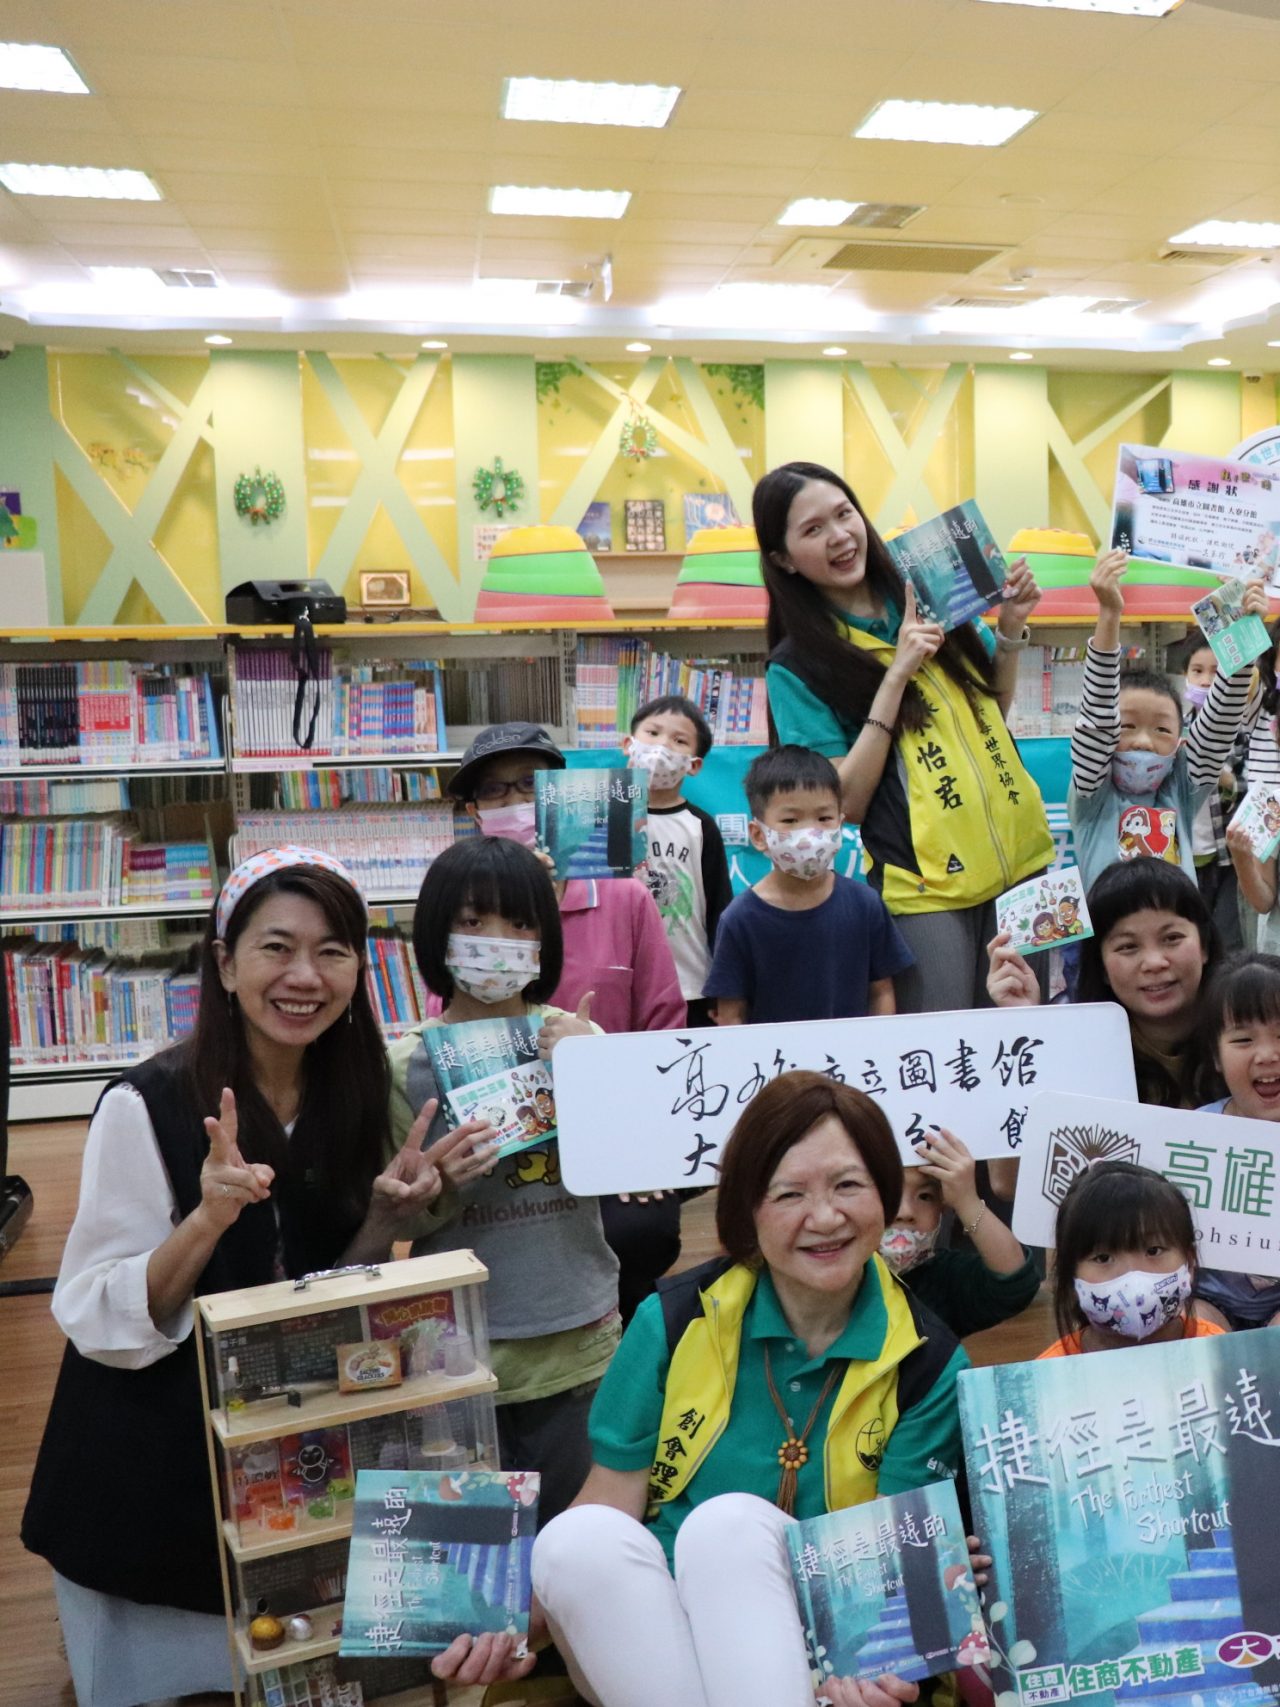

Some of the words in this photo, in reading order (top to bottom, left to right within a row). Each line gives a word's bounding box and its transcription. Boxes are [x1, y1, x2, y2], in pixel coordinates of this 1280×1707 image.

[1172, 497, 1225, 514] 高雄市立圖書館
[1187, 479, 1238, 497] 感謝狀
[1071, 1486, 1113, 1530] The
[1120, 1470, 1194, 1513] Furthest
[1136, 1501, 1233, 1544] Shortcut
[365, 1486, 412, 1651] 捷徑是最遠的
[796, 1511, 947, 1583] 捷徑是最遠的
[1025, 1669, 1060, 1688] 住商
[1068, 1648, 1201, 1694] 住商不動產
[1028, 1690, 1060, 1702] 不動產
